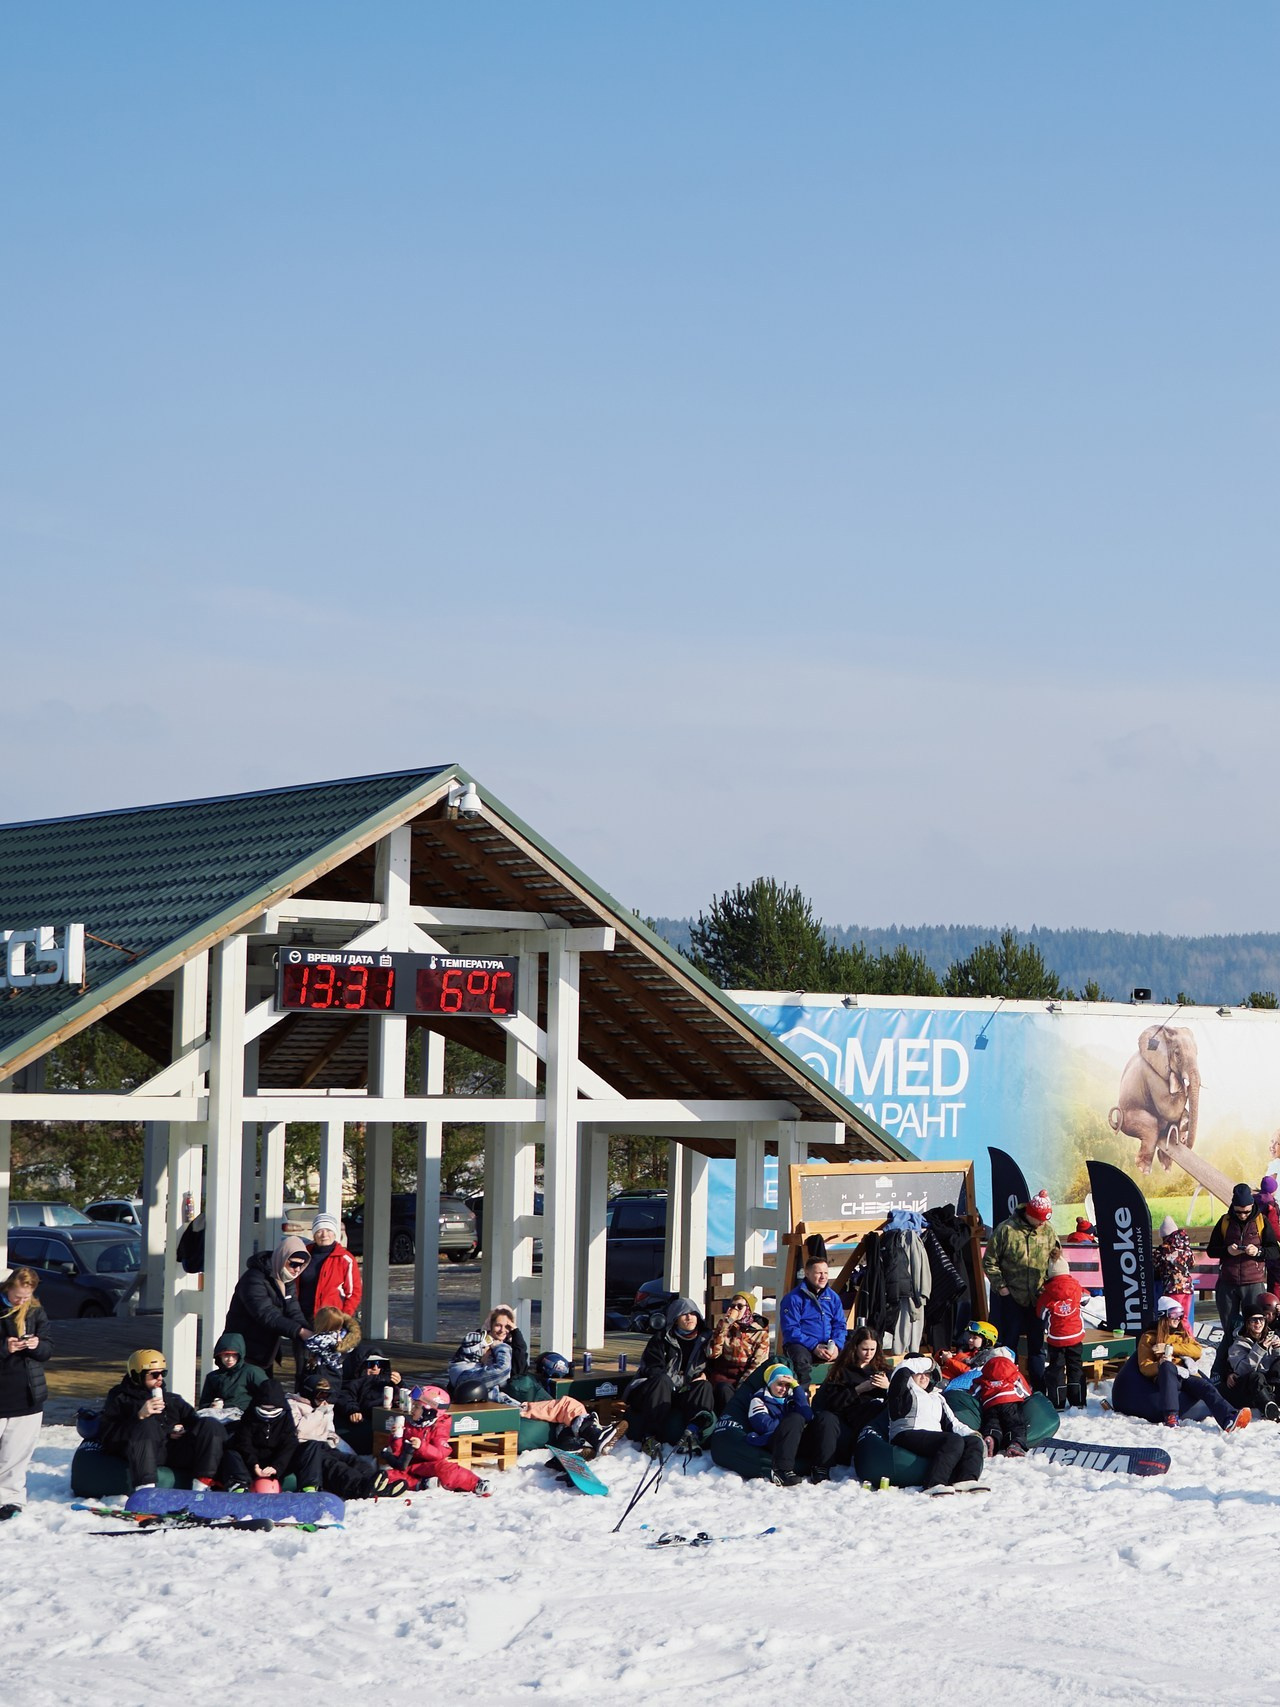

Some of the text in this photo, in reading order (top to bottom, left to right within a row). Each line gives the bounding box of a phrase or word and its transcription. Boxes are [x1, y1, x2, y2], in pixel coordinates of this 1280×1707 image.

[308, 953, 342, 963] ВРЕМЯ
[348, 955, 374, 965] ДАТА
[441, 958, 504, 969] ТЕМПЕРАТУРА
[300, 965, 394, 1009] 13:31
[845, 1038, 969, 1096] MED
[1113, 1207, 1142, 1330] invoke
[1137, 1227, 1148, 1310] ENERGY DRINK
